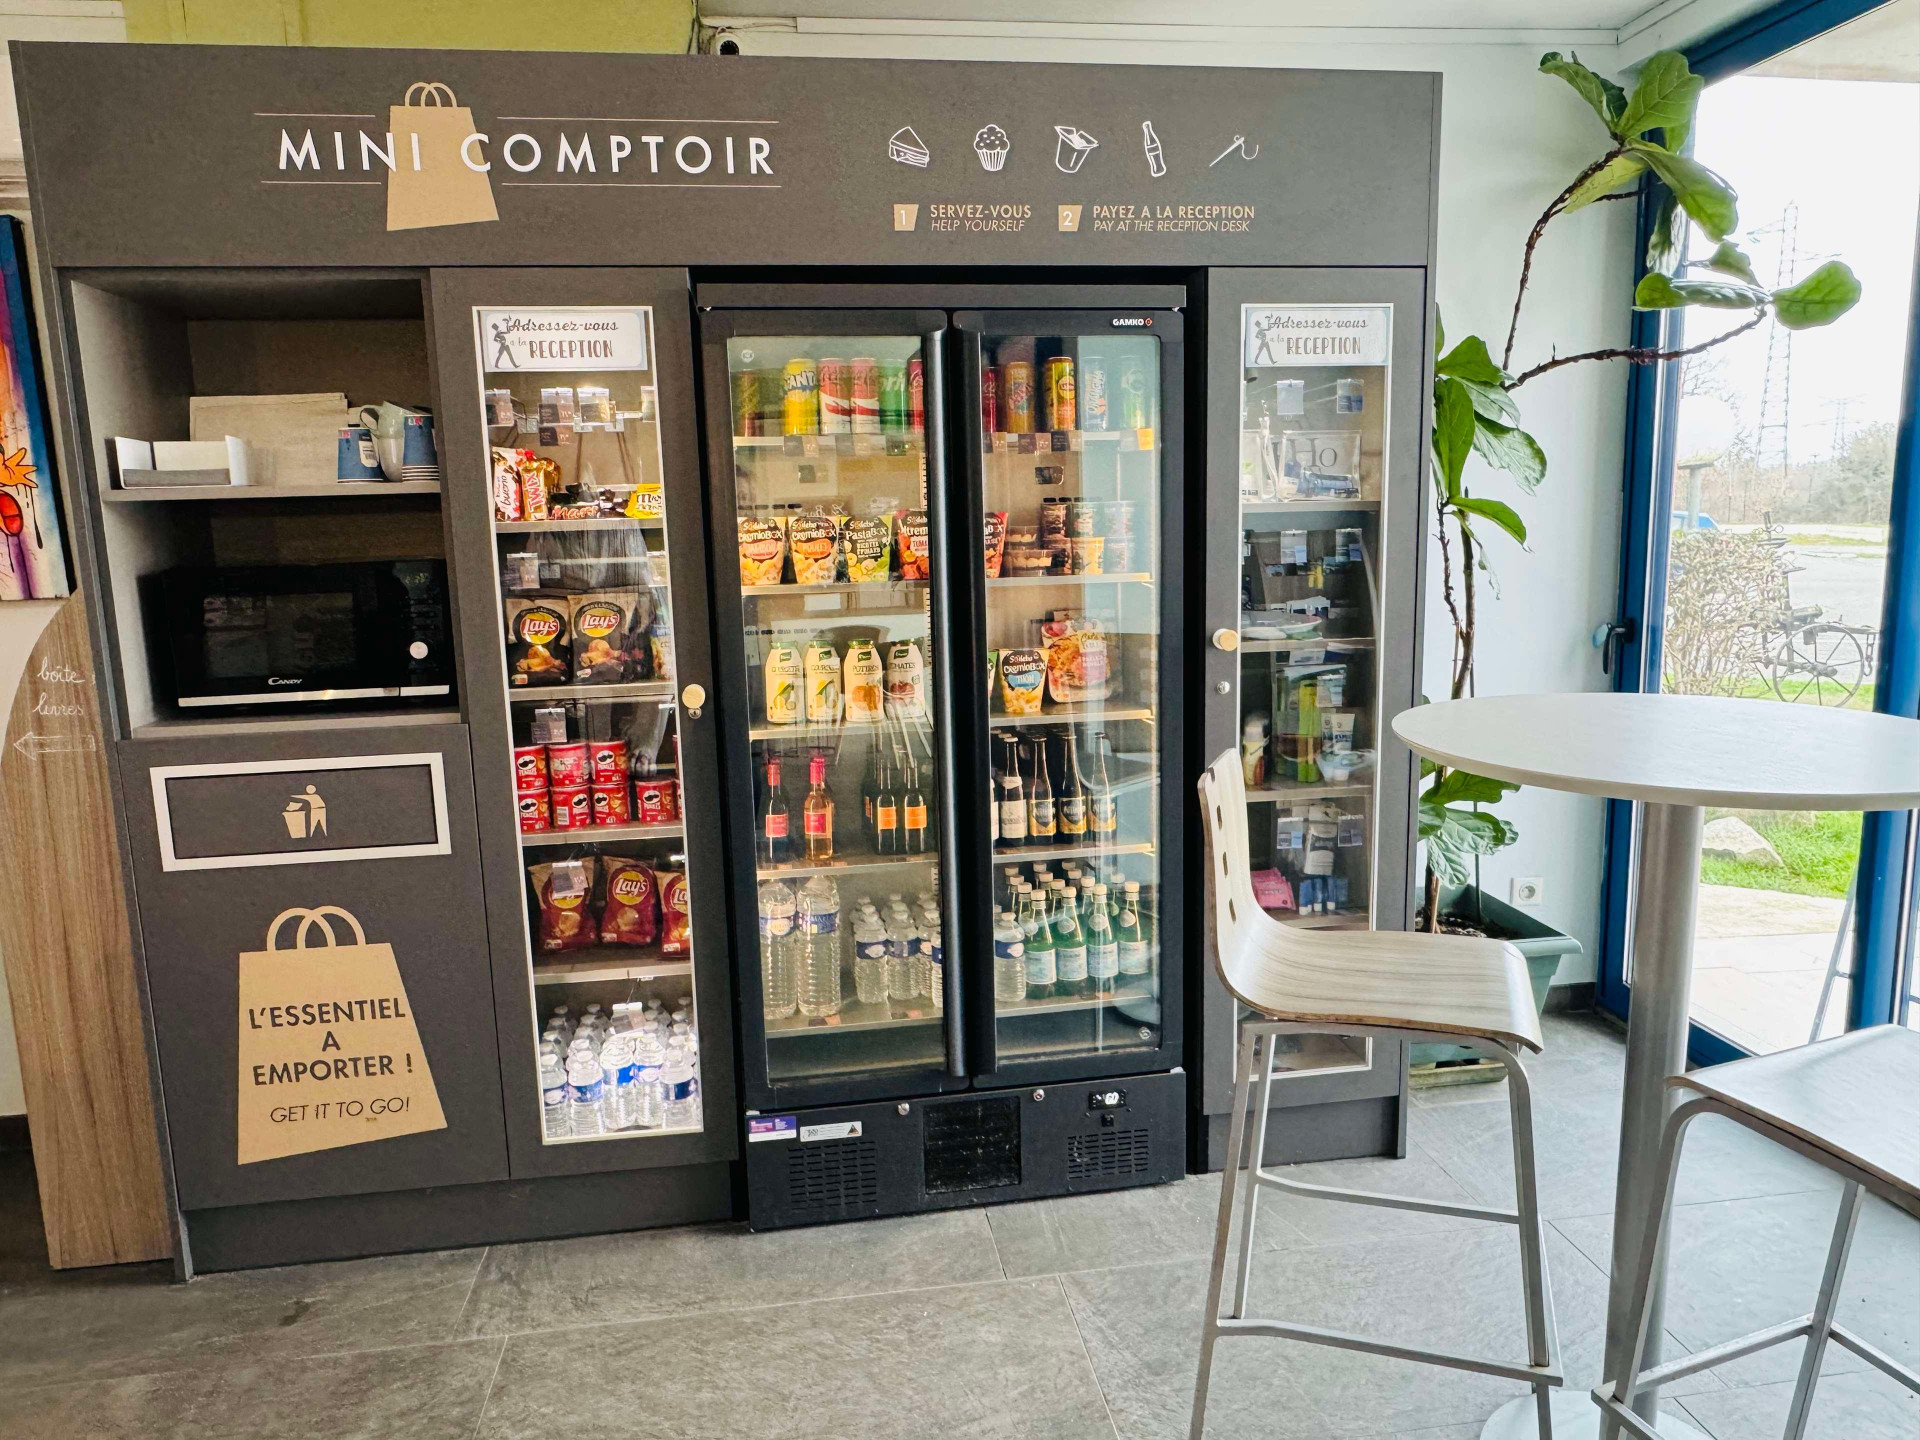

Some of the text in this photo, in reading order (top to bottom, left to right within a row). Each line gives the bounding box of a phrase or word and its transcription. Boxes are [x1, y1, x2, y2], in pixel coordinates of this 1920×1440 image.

[279, 129, 774, 175] MINI COMPTOIR
[899, 210, 907, 225] 1
[930, 205, 1032, 219] SERVEZ-VOUS
[1063, 211, 1073, 226] 2
[1093, 206, 1255, 219] PAYEZ A LA RECEPTION
[931, 219, 1025, 232] HELP YOURSELF
[1094, 220, 1251, 232] PAY AT THE RECEPTION DESK
[508, 318, 619, 332] Adressez-vous
[1112, 318, 1145, 326] GAMKO
[1269, 315, 1369, 329] Adressez-vous
[529, 339, 614, 359] RECEPTION
[1286, 336, 1361, 355] RECEPTION
[526, 471, 546, 513] TWIX
[523, 617, 558, 637] Lay's
[583, 611, 621, 630] Lay's
[37, 656, 86, 683] boîte
[32, 692, 85, 716] livres
[615, 876, 650, 897] Lay's
[249, 998, 406, 1030] L'ESSENTIEL
[321, 1030, 341, 1052] A
[252, 1053, 413, 1086] EMPORTER !
[270, 1097, 410, 1123] GET IT TO GO!
